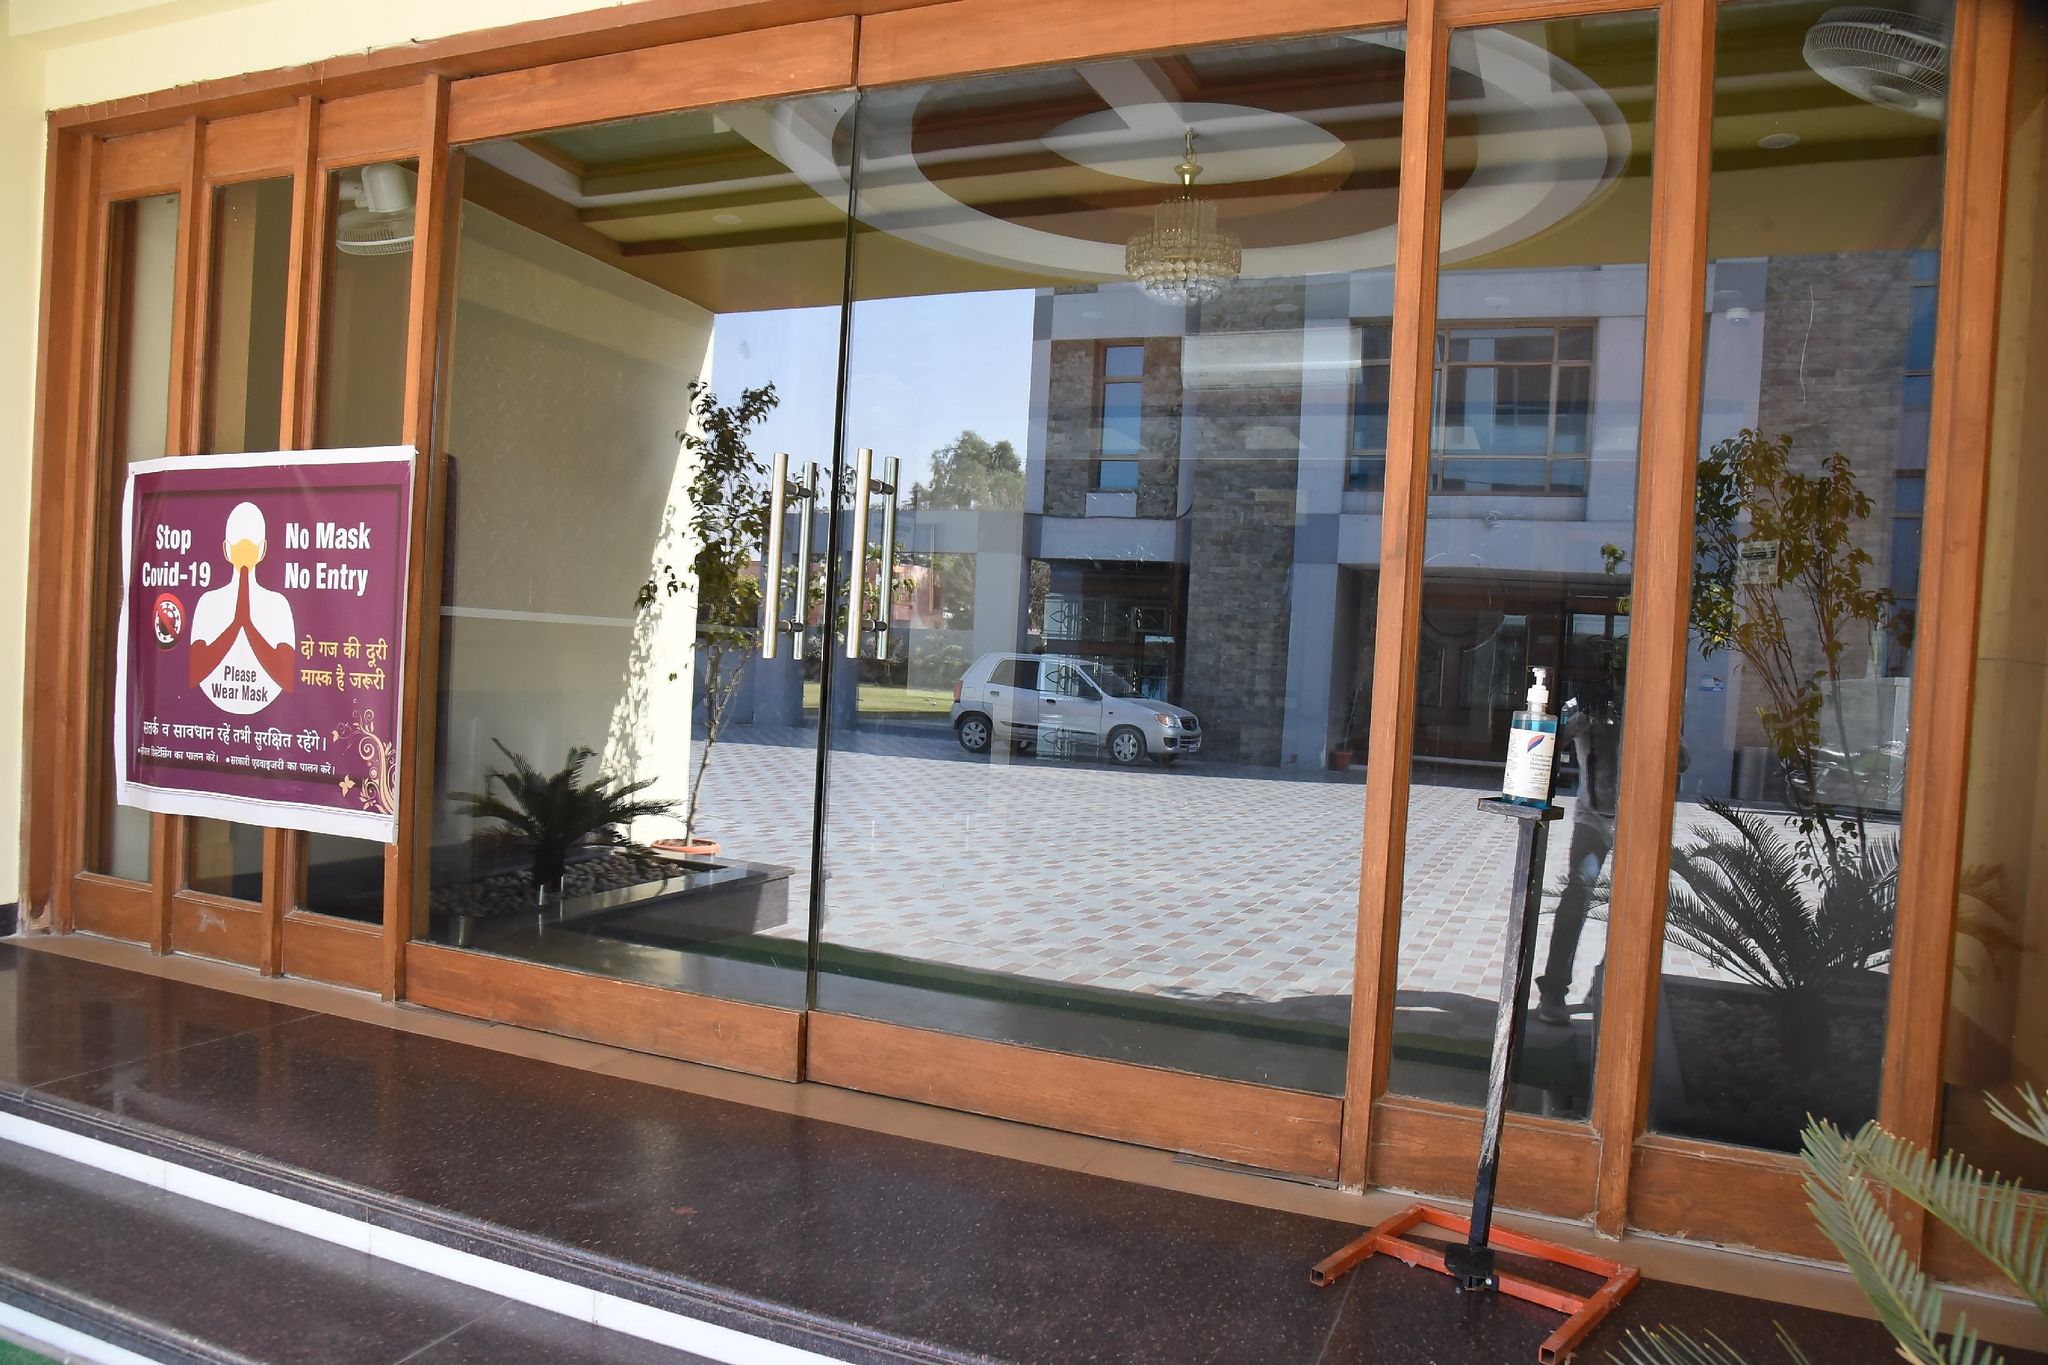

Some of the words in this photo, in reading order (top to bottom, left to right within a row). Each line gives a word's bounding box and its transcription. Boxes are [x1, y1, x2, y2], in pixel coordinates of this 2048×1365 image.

[156, 524, 192, 555] Stop
[285, 522, 310, 549] No
[315, 522, 371, 550] Mask
[142, 561, 211, 588] Covid-19
[284, 562, 310, 589] No
[315, 563, 369, 597] Entry
[300, 634, 315, 661] दो
[318, 641, 339, 658] गज
[343, 636, 362, 660] की
[365, 638, 389, 668] दूरी
[224, 665, 257, 683] Please
[300, 669, 333, 687] मास्क
[335, 663, 346, 692] है
[349, 667, 386, 690] जरूरी
[211, 683, 239, 700] Wear
[241, 684, 269, 703] Mask
[162, 723, 171, 737] व
[173, 724, 215, 740] सावधान
[217, 722, 231, 746] रहें
[233, 725, 252, 745] तभी
[254, 727, 293, 751] सुरक्षित
